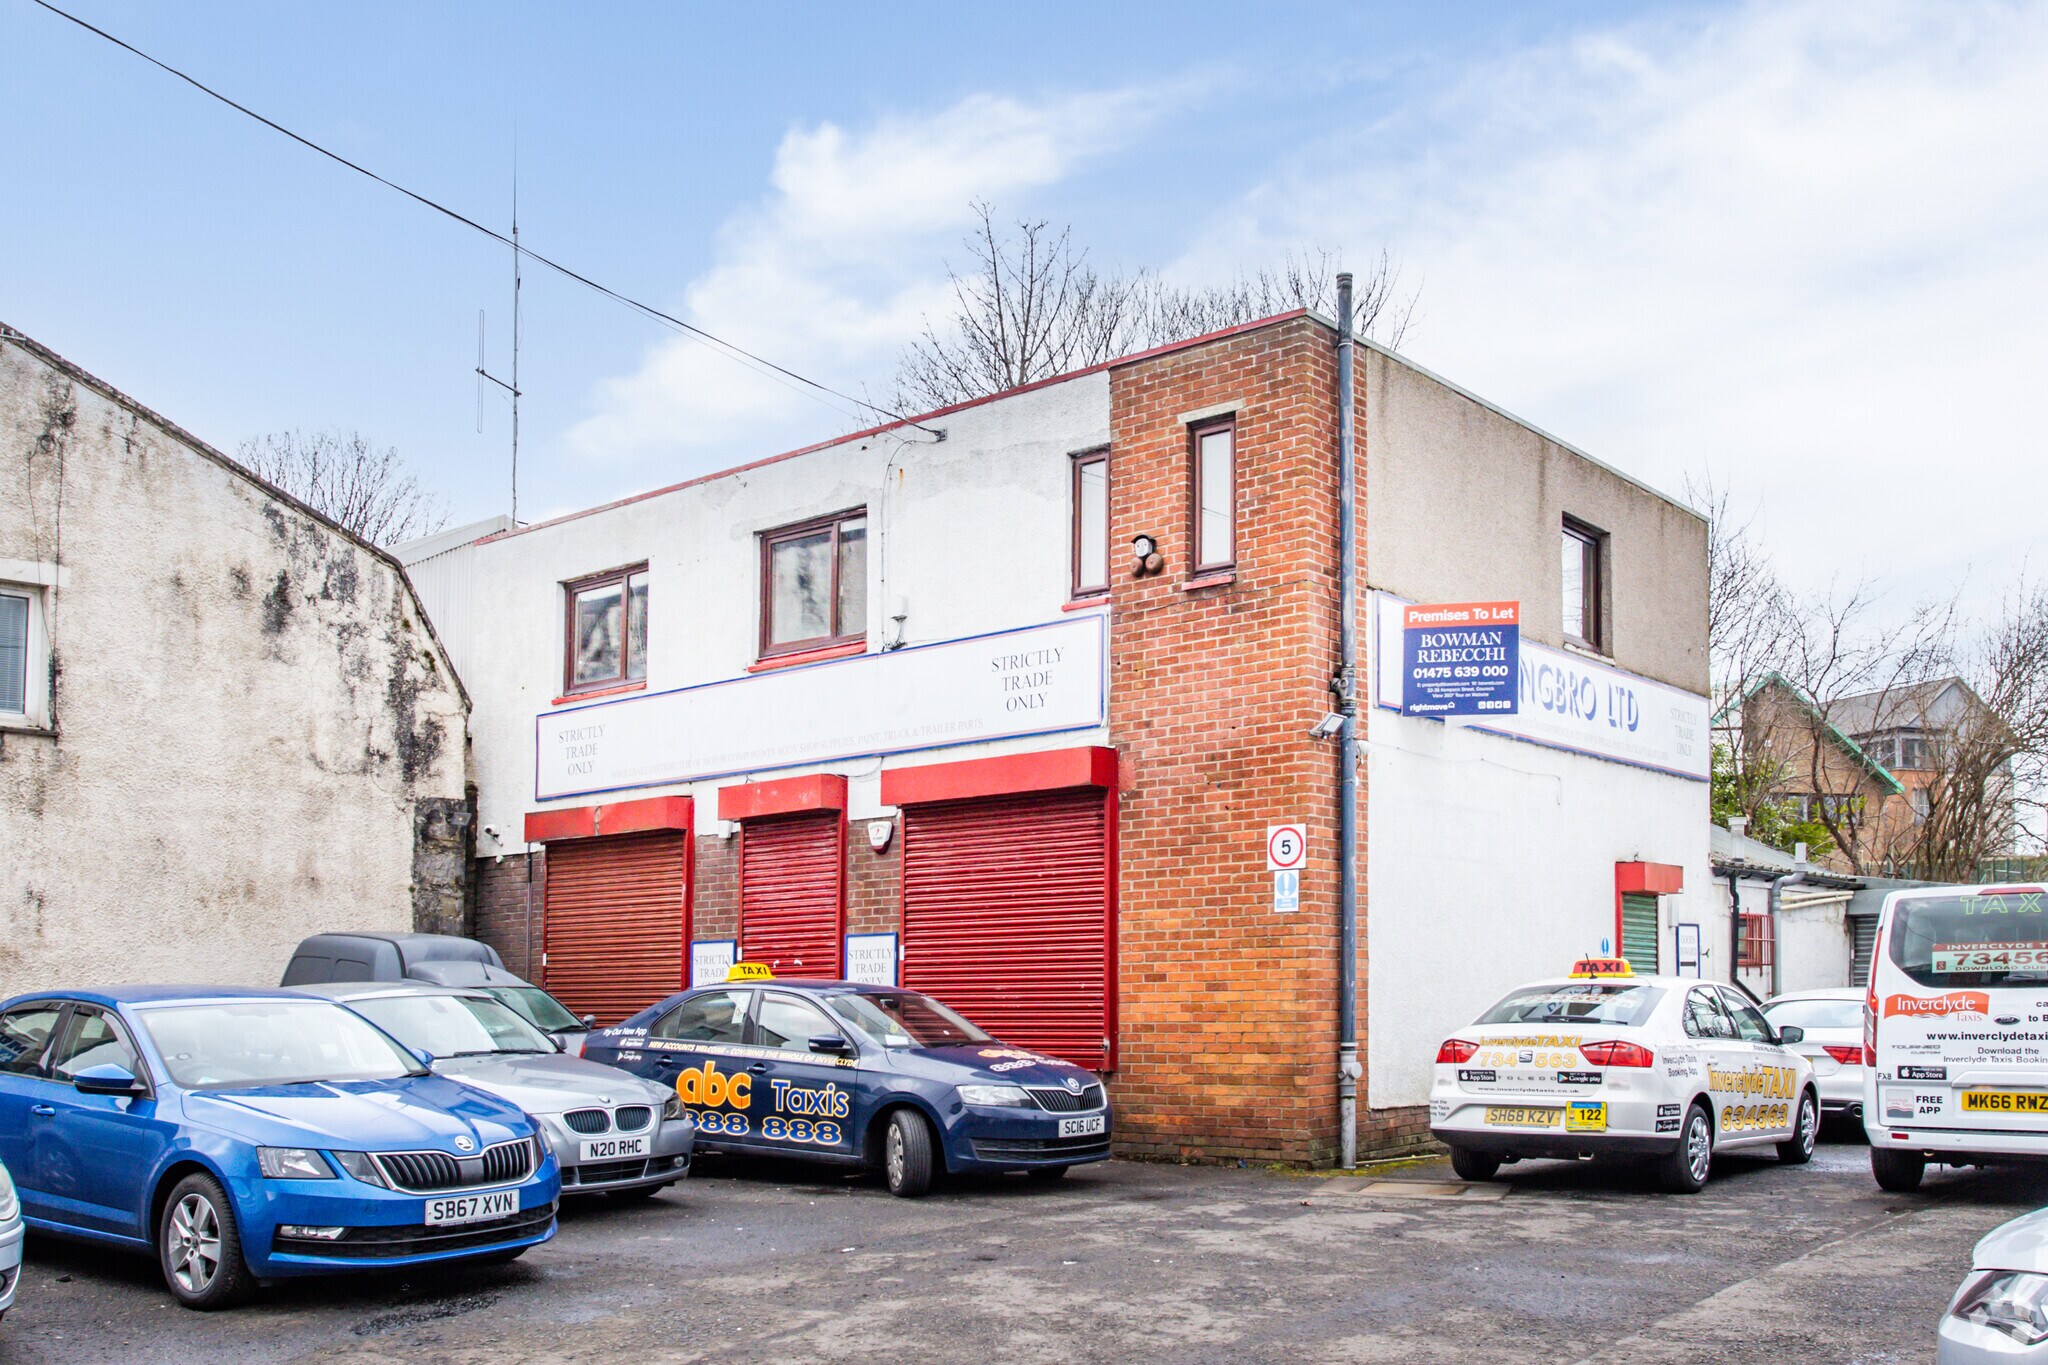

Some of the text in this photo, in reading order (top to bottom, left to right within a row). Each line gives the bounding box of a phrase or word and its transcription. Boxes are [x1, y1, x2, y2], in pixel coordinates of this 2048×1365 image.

[1409, 608, 1514, 622] Premises To Let
[1421, 632, 1502, 648] BOWMAN
[992, 646, 1064, 672] STRICTLY
[1417, 647, 1506, 663] REBECCHI
[1413, 665, 1508, 679] 01475 639 000
[1002, 670, 1054, 692] TRADE
[1006, 692, 1048, 712] ONLY
[1410, 702, 1448, 712] rightmove
[1608, 681, 1638, 732] LTD
[558, 724, 606, 744] STRICTLY
[921, 720, 956, 736] TRAILER
[958, 718, 984, 731] PARTS
[566, 742, 598, 760] TRADE
[568, 760, 596, 776] ONLY
[1282, 840, 1292, 856] 5
[1960, 893, 2042, 915] TAX
[849, 948, 893, 960] STRICTLY
[1946, 942, 2033, 950] INVERCLYDE
[694, 954, 732, 966] STRICTLY
[855, 962, 888, 974] TRADE
[1578, 962, 1620, 972] TAXI
[699, 968, 728, 978] TRADE
[740, 966, 768, 975] TAXI
[1897, 996, 1976, 1013] Inverclyde
[1956, 1012, 1982, 1022] Taxis
[602, 1028, 612, 1037] Try
[635, 1026, 648, 1036] App
[1927, 1032, 2048, 1042] www.inverclydetaxi
[648, 1040, 664, 1050] NEW
[663, 1042, 696, 1052] ACCOUNTS
[695, 1044, 726, 1054] WELCOME
[730, 1047, 764, 1058] COVERING
[765, 1050, 779, 1058] THE
[779, 1051, 804, 1061] WHOLE
[804, 1054, 815, 1062] OF
[815, 1056, 858, 1067] INVERCLYDE
[1480, 1052, 1578, 1068] 734 563
[1662, 1056, 1686, 1066] Inverclyde
[1944, 1056, 1987, 1064] Inverclyde
[1990, 1056, 2012, 1064] Taxis
[1668, 1068, 1688, 1078] Booking
[676, 1060, 752, 1110] abc
[771, 1078, 850, 1118] Taxis
[1916, 1096, 1943, 1104] FREE
[1968, 1094, 2048, 1110] MK66 RWZ
[1490, 1109, 1555, 1124] SH68 KZV
[1580, 1108, 1602, 1120] 122
[1720, 1103, 1788, 1132] 634563
[762, 1116, 842, 1146] 888
[1064, 1118, 1100, 1134] SC16 UCF
[590, 1139, 642, 1158] N20 RHC
[434, 1193, 513, 1220] SB67 XVN
